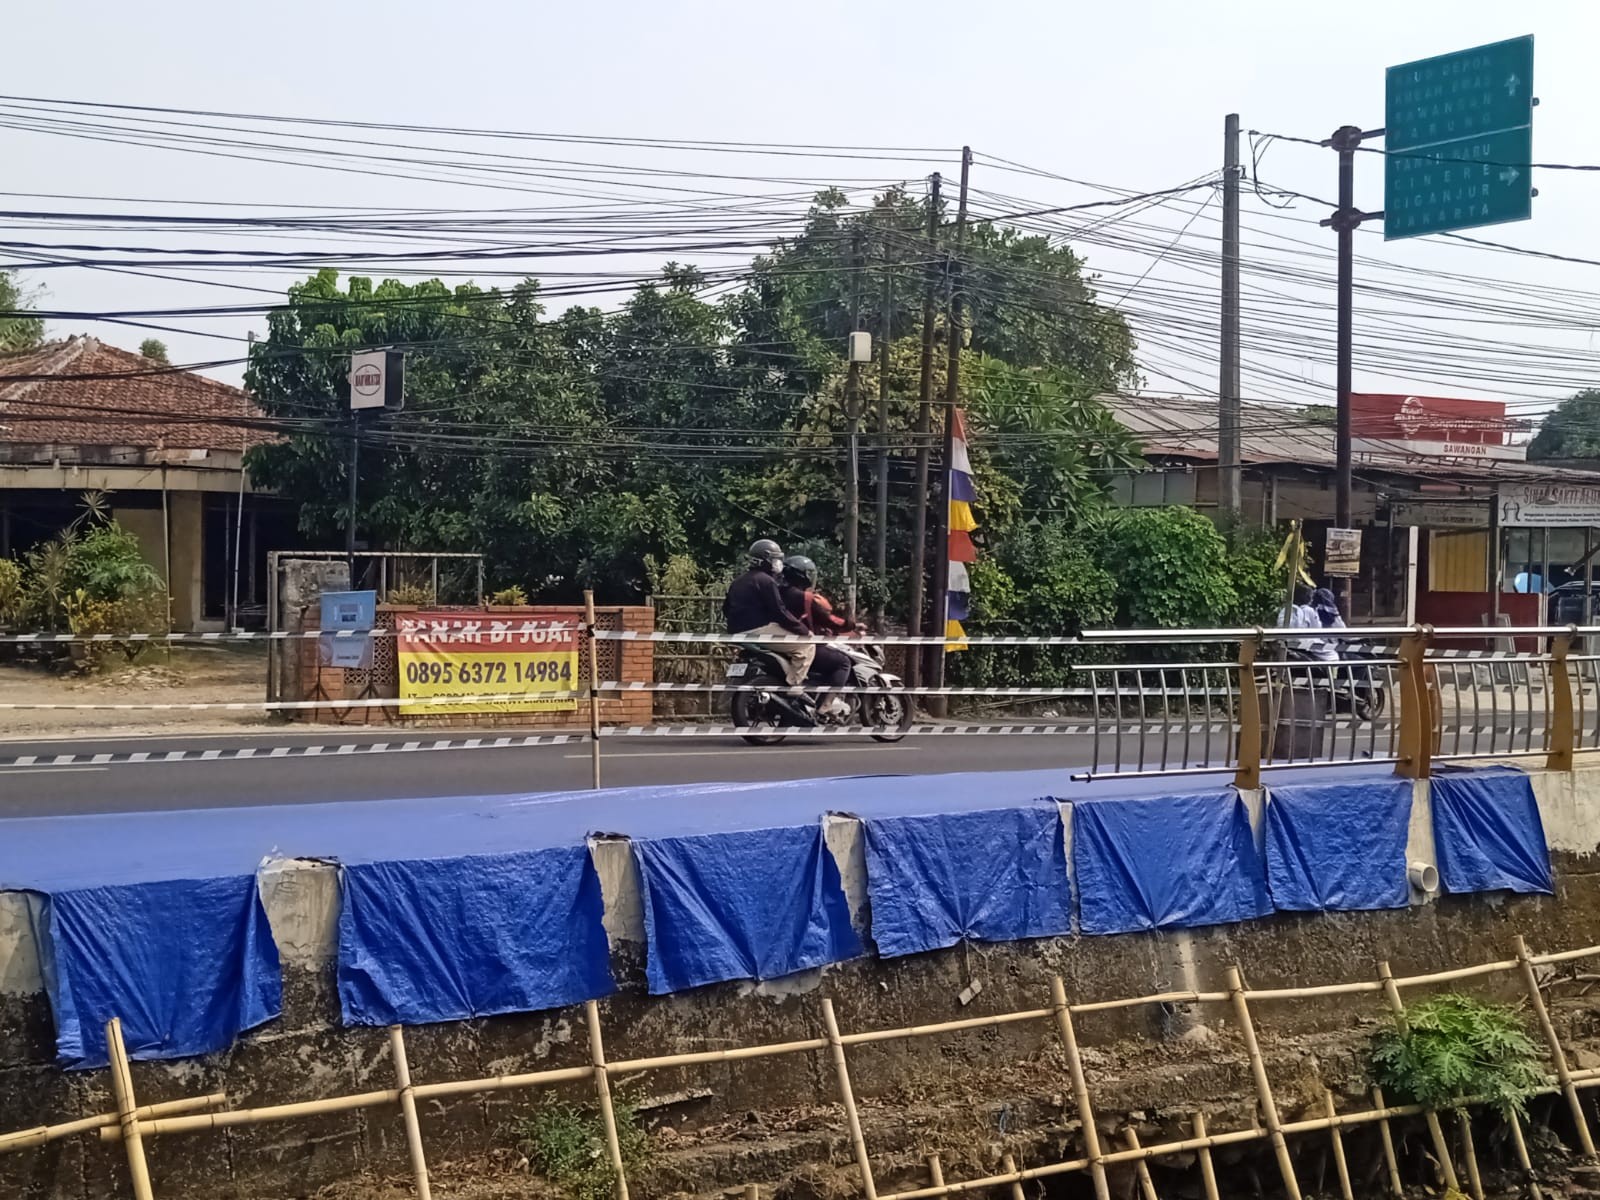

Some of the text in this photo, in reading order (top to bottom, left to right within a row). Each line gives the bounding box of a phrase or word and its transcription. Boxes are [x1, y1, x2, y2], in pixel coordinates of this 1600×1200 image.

[1394, 163, 1490, 190] CINERE
[1394, 183, 1490, 209] CIGANJUR
[1394, 203, 1489, 229] JAKARTA
[1443, 444, 1487, 456] SAWANGAN
[402, 619, 572, 644] TANAH DI JUAL
[406, 660, 572, 684] 0895 6372 14984
